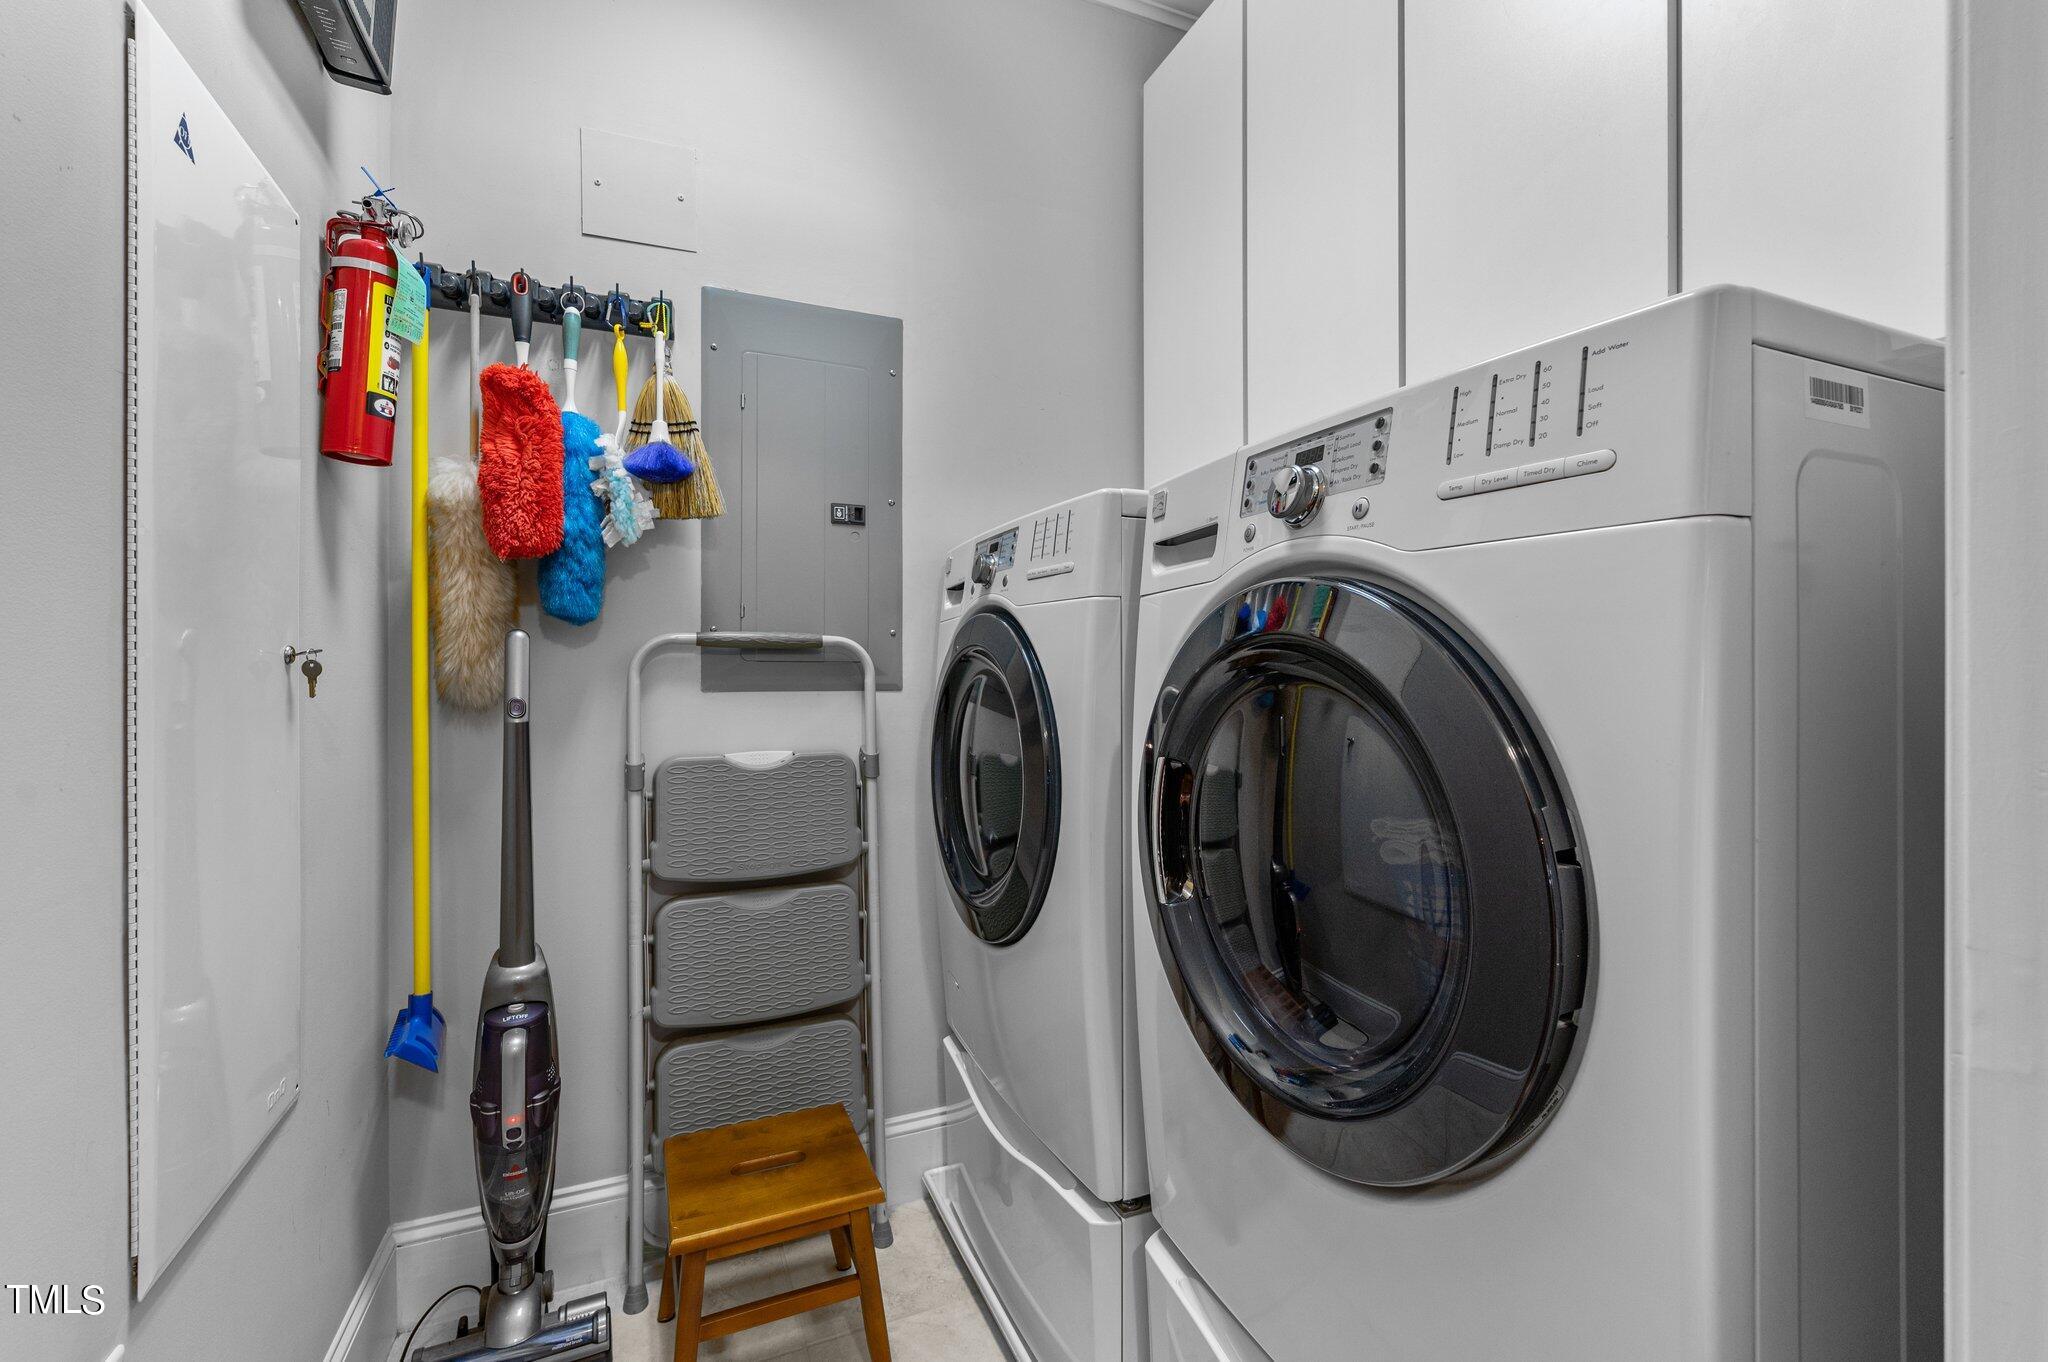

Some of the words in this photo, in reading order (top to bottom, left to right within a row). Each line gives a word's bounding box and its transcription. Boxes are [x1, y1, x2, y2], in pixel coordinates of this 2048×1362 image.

[1592, 347, 1606, 356] Add
[1608, 341, 1630, 351] Water
[1543, 365, 1553, 373] 60
[1499, 377, 1515, 386] Extra
[1515, 373, 1528, 381] Dry
[1542, 381, 1551, 390] 50
[1588, 384, 1605, 394] Loud
[1460, 389, 1472, 399] High
[1587, 401, 1603, 411] Soft
[1496, 406, 1519, 417] Normal
[1456, 418, 1479, 428] Medium
[1539, 414, 1549, 422] 30
[1585, 419, 1599, 429] Off
[1538, 431, 1548, 440] 20
[1493, 441, 1512, 450] Damp
[1512, 437, 1525, 446] Dry
[1576, 457, 1599, 469] Chime
[1523, 467, 1543, 478] Timed
[1543, 466, 1557, 475] Dry
[1481, 477, 1493, 486] Dry
[1493, 474, 1509, 483] Level
[1448, 484, 1464, 493] Temp
